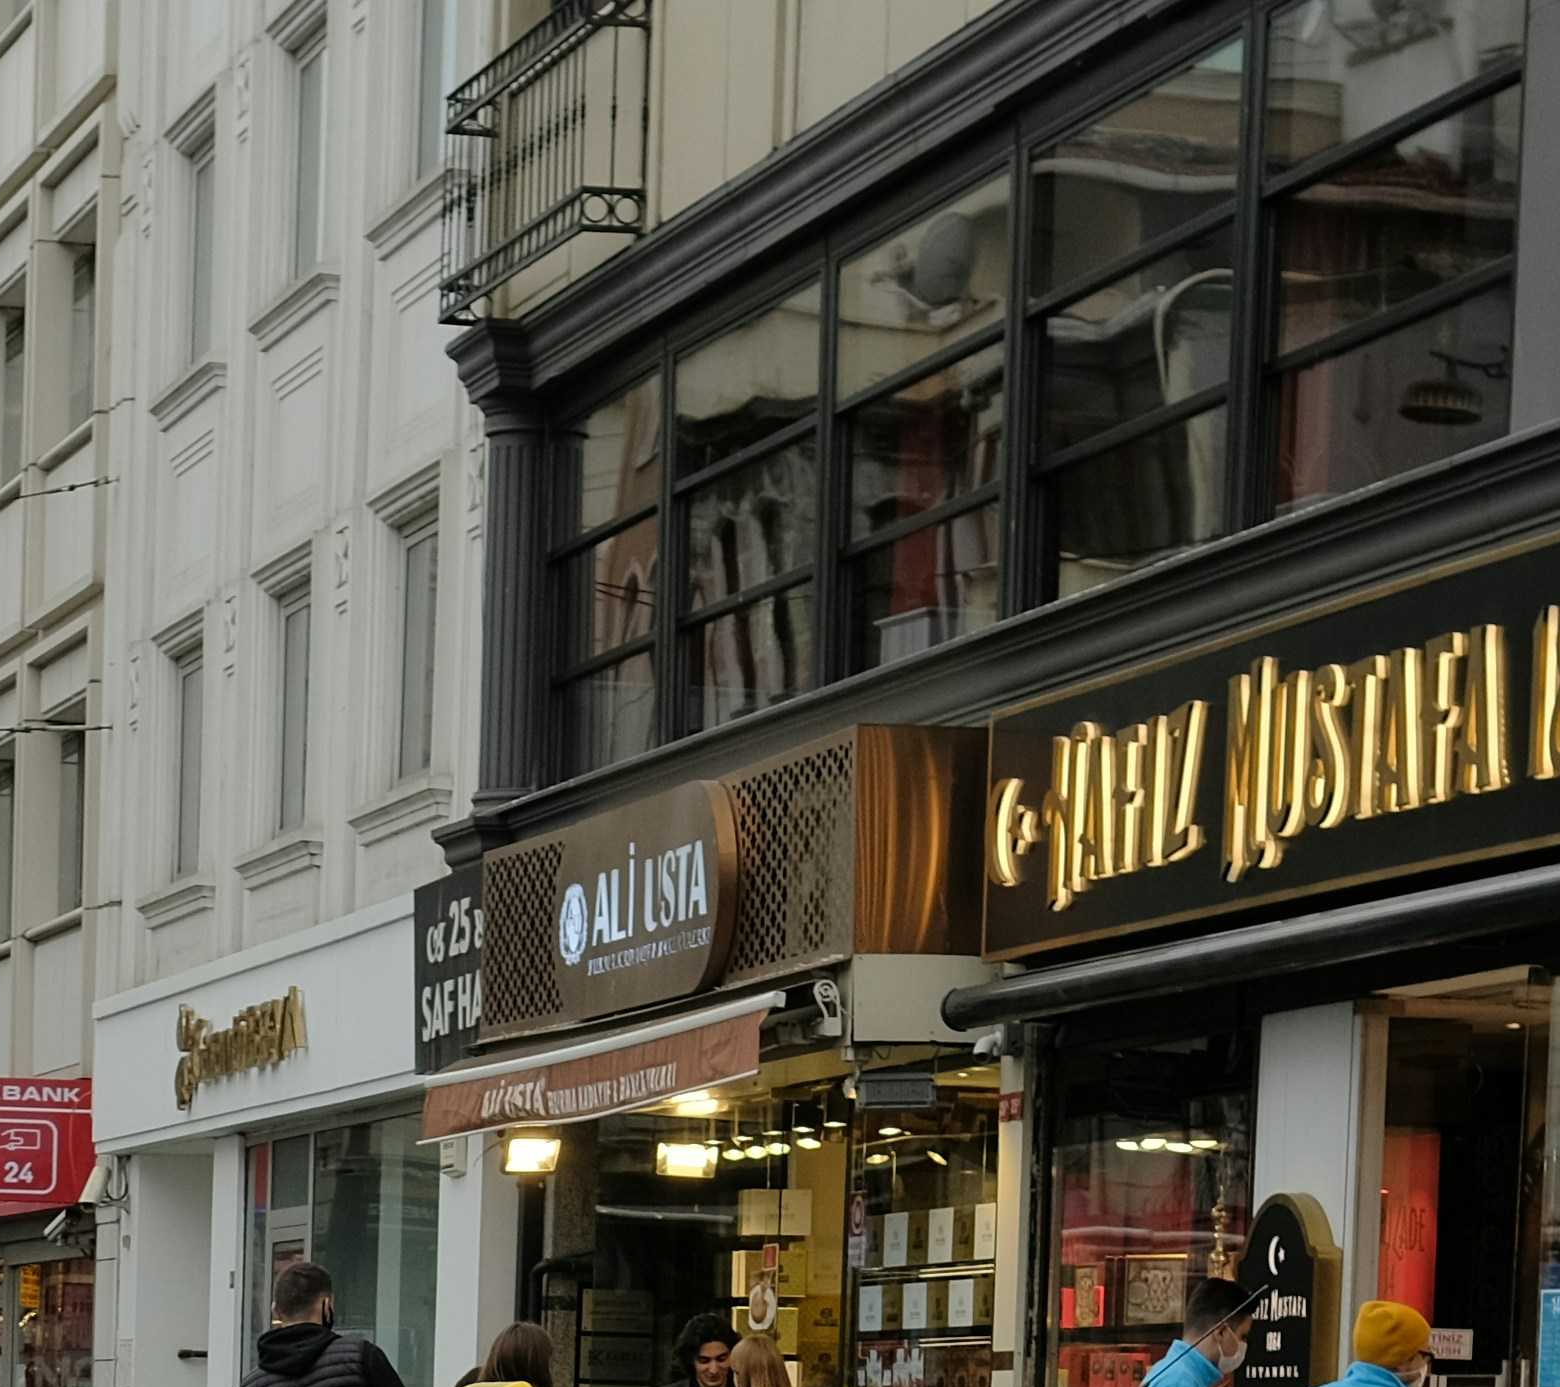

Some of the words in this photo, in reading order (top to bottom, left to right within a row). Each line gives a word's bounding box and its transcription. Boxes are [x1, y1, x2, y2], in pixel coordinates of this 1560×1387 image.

[1220, 622, 1510, 883] MUSTAFA
[591, 841, 636, 947] ALİ
[644, 839, 709, 933] USTA
[447, 896, 472, 958] 25
[421, 979, 456, 1044] SAF
[3, 1161, 35, 1184] 24
